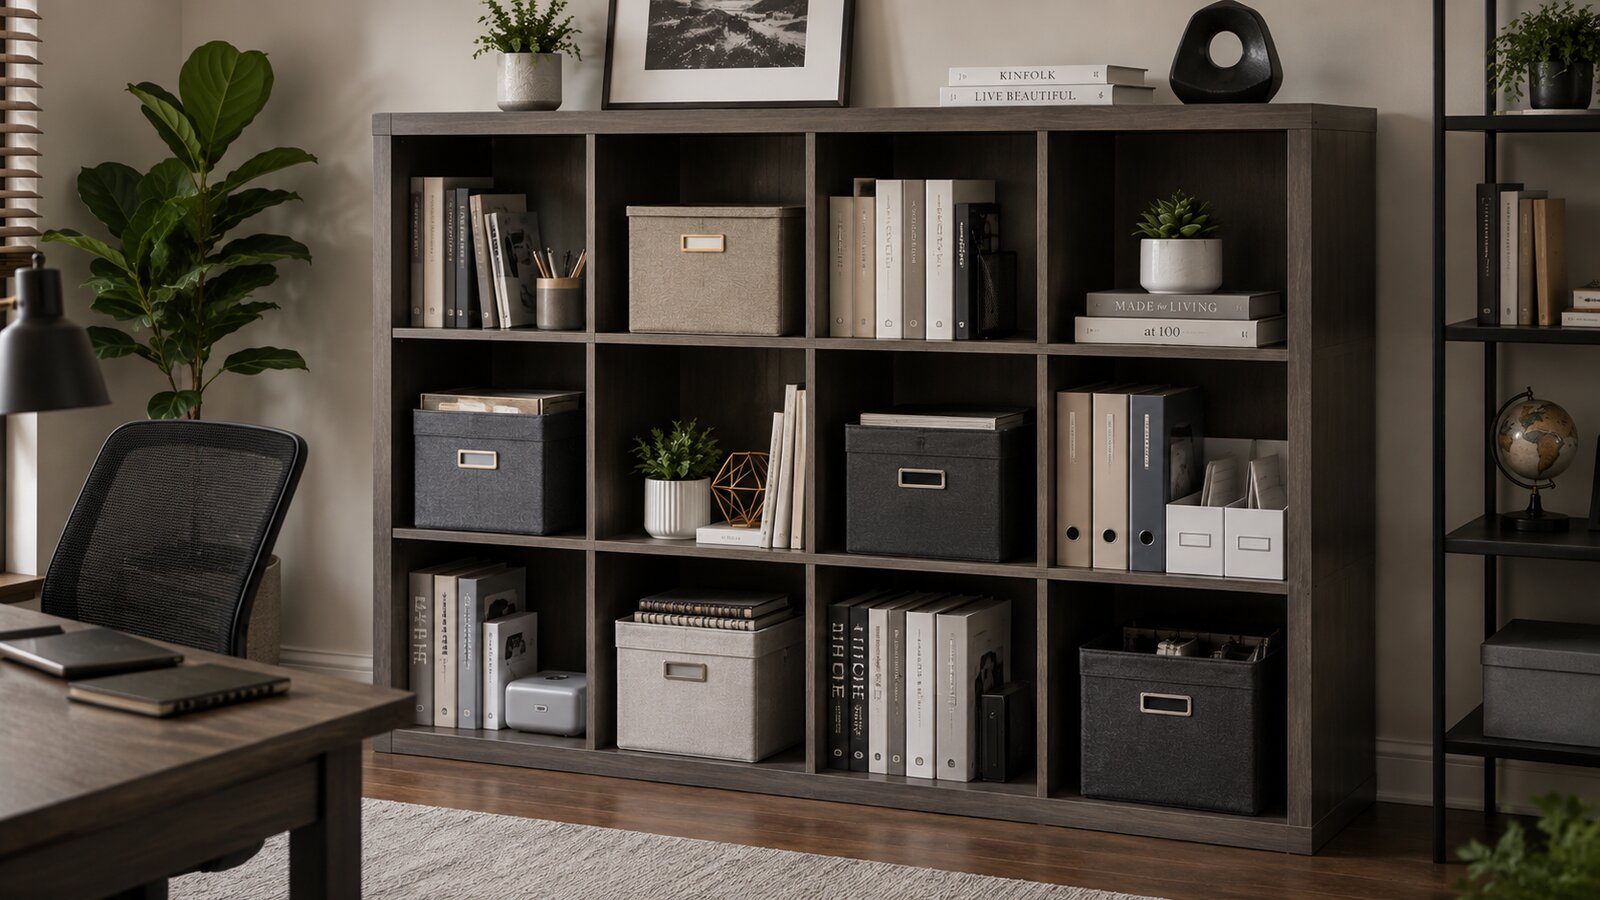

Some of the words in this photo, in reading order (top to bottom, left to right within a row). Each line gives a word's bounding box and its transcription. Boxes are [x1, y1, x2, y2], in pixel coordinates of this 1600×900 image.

[1000, 71, 1056, 80] KINFOLK
[975, 91, 1003, 101] LIVE
[1007, 91, 1076, 101] BEAUTIFUL
[1115, 301, 1154, 312] MADE
[1170, 301, 1217, 313] LIVING
[1144, 327, 1155, 337] at
[1159, 326, 1181, 337] 100
